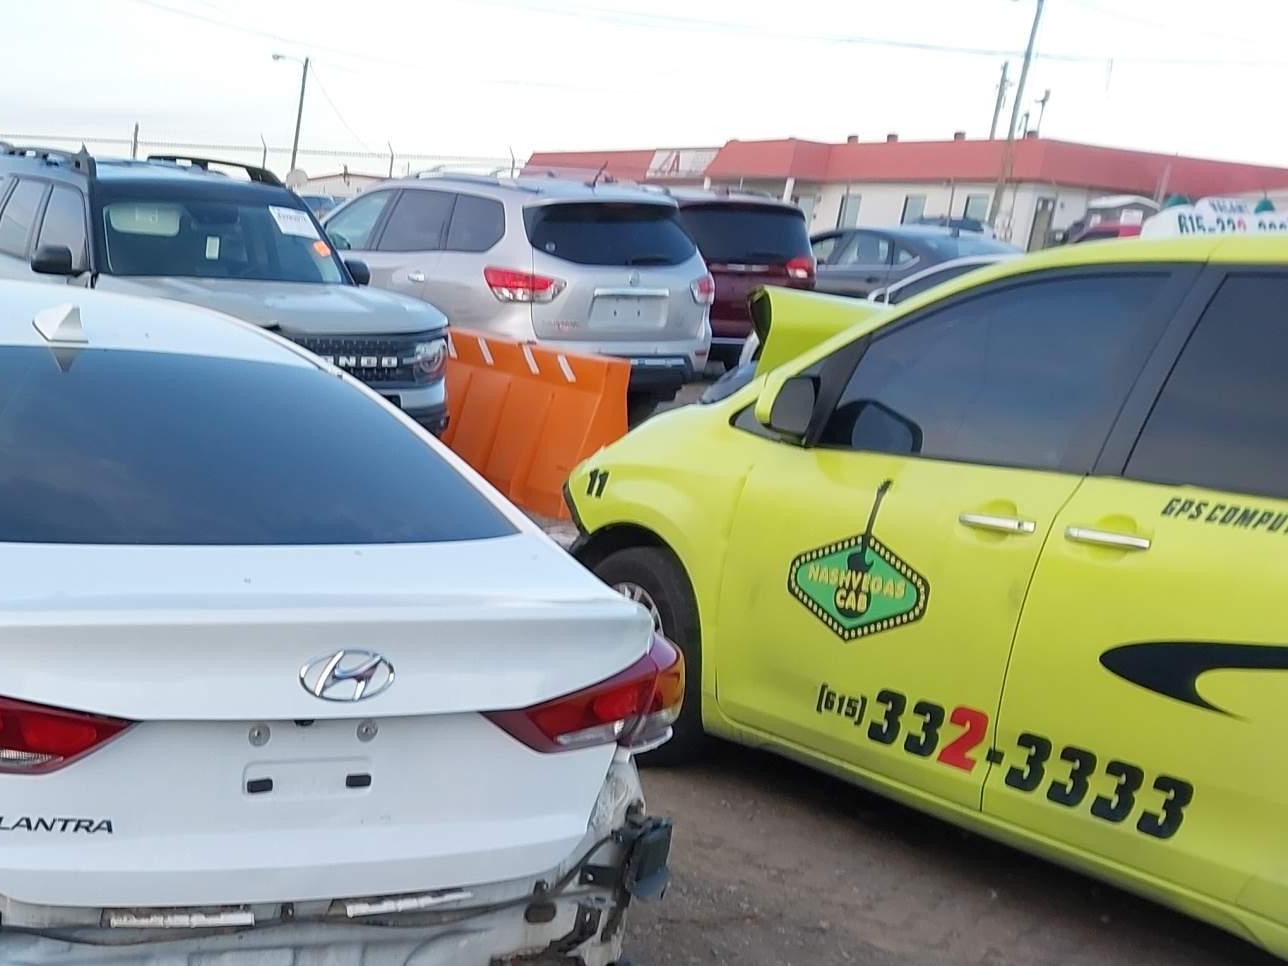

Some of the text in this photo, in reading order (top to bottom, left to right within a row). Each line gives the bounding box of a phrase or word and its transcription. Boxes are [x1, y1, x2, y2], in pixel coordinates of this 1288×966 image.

[586, 468, 610, 499] 11
[1161, 497, 1288, 534] GPS COMPU
[807, 562, 907, 600] NASHVEGAS
[835, 587, 868, 614] CAB
[867, 689, 1195, 840] 332-3333
